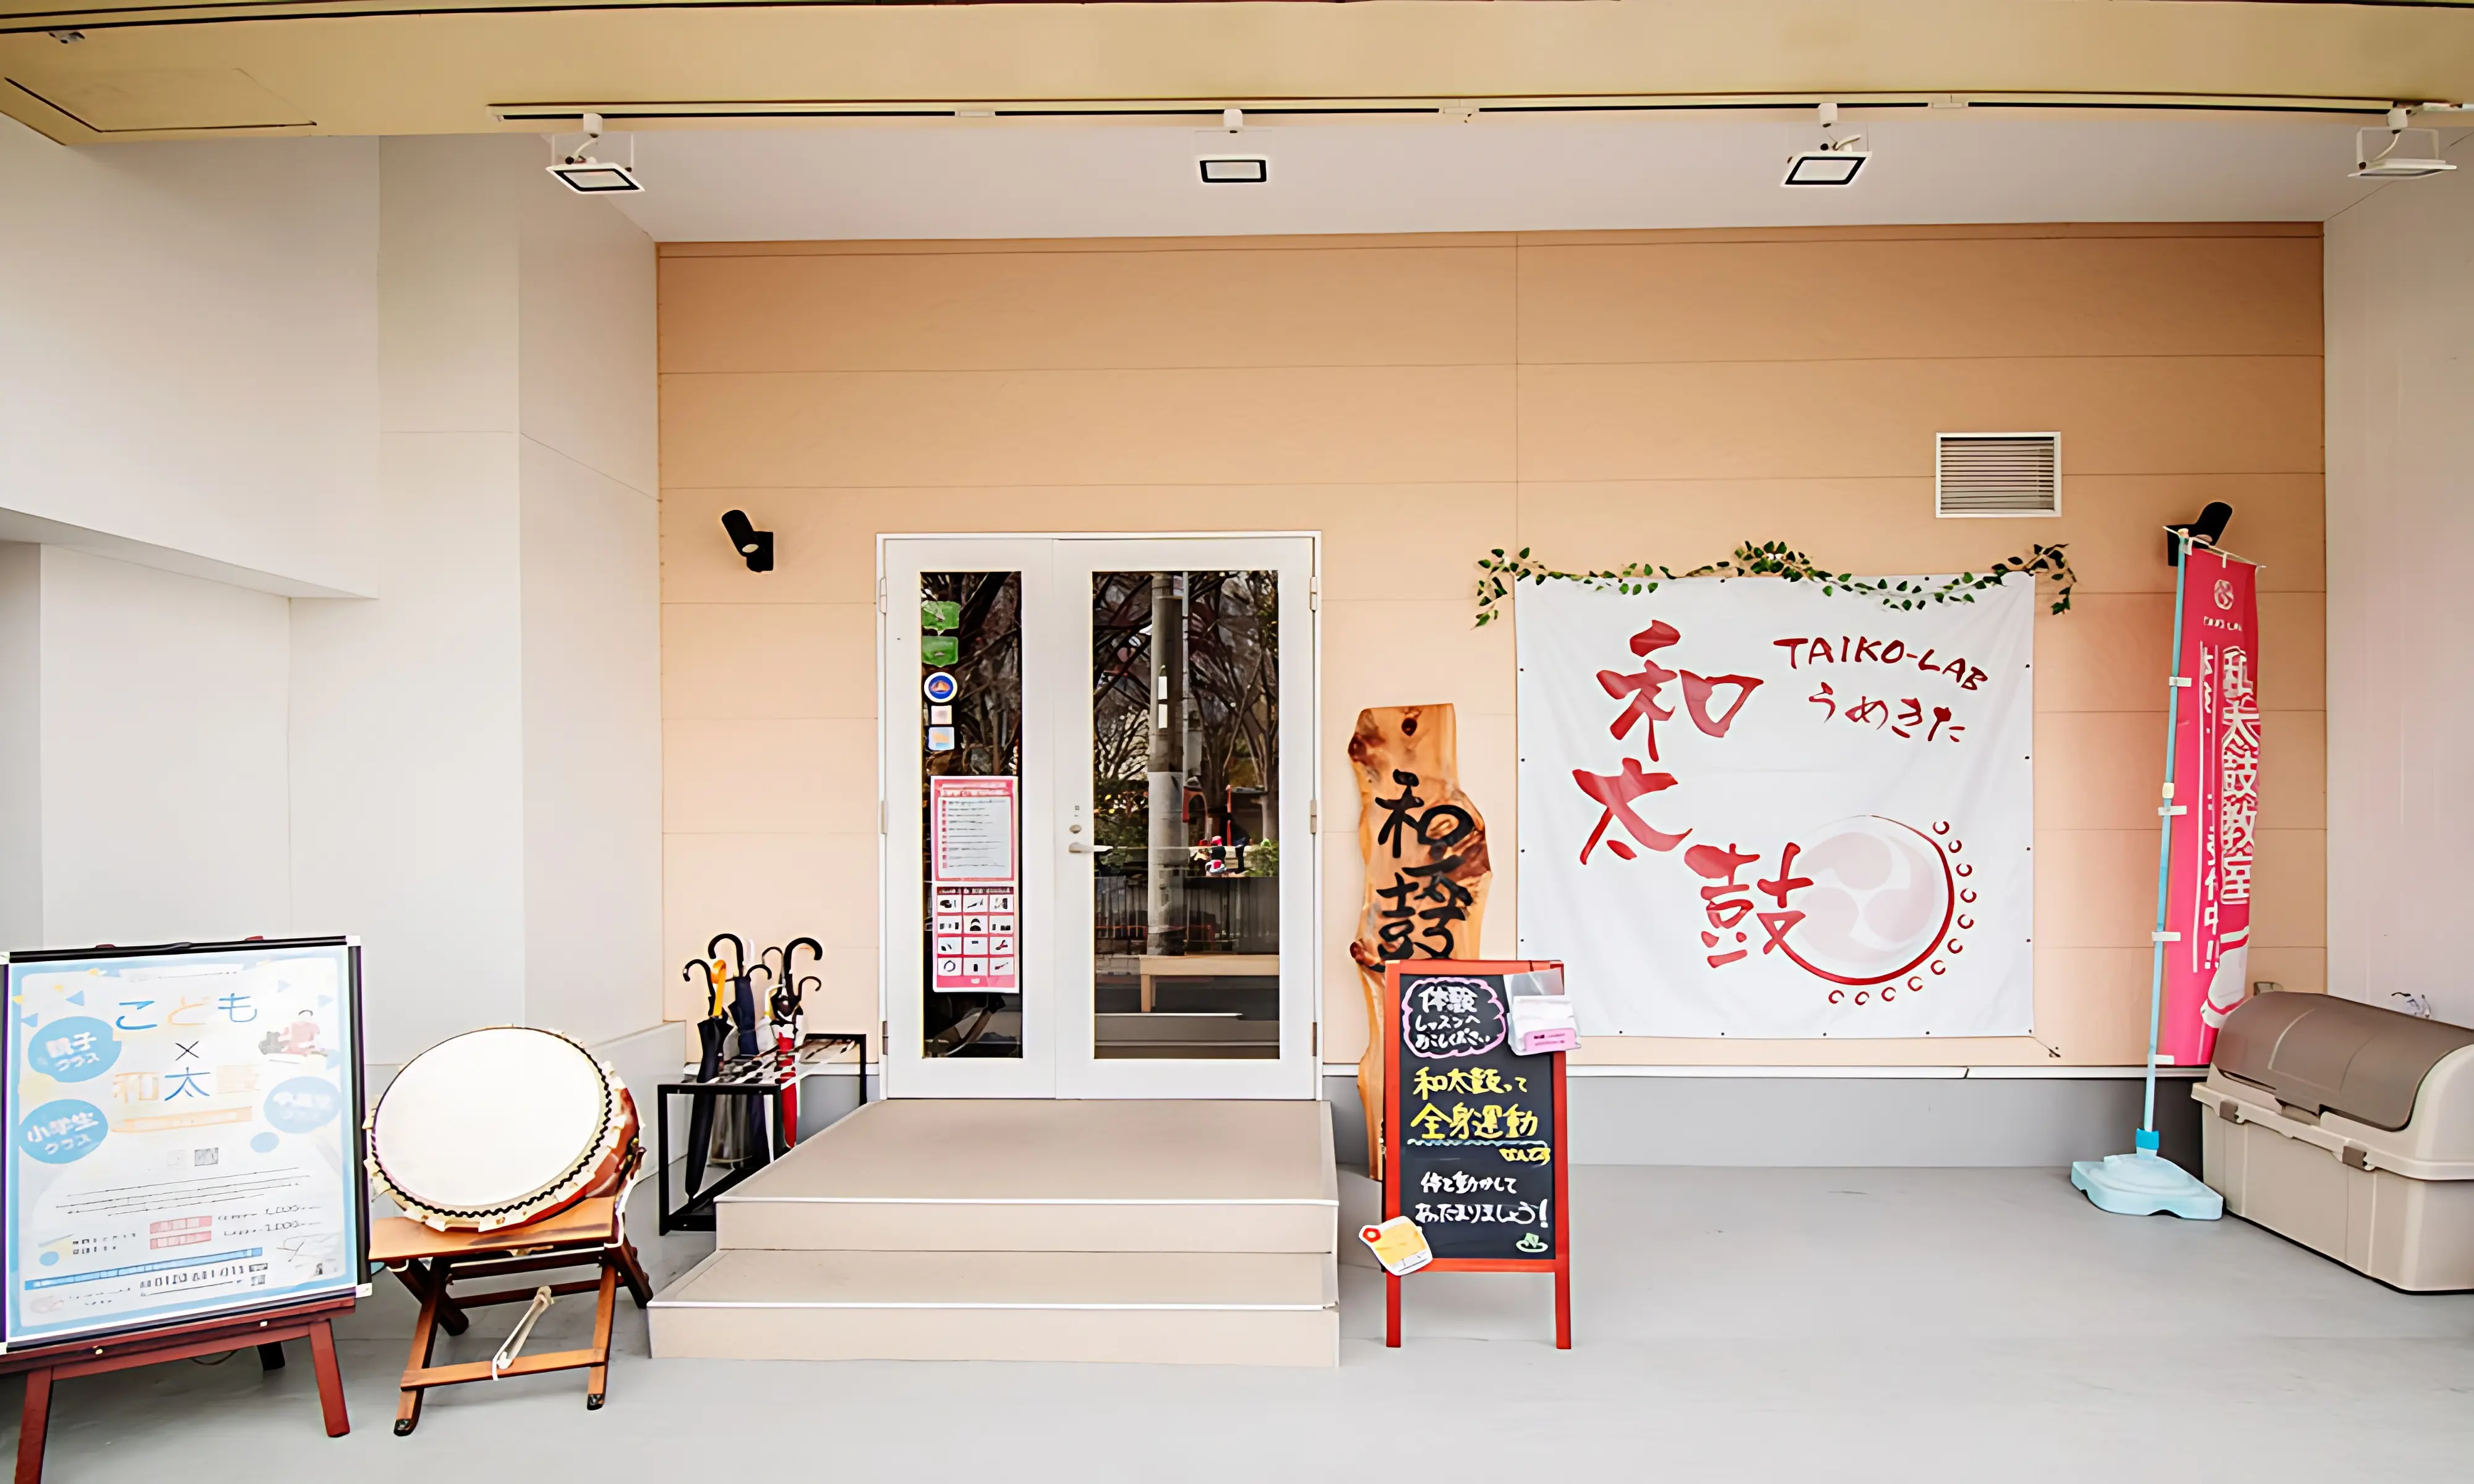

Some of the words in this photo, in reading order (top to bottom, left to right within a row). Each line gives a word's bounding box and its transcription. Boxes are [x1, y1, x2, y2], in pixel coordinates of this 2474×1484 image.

[1773, 635, 1989, 691] TAIKO-LAB
[1808, 681, 1966, 743] うめきた
[1572, 619, 1815, 970] 和太鼓
[115, 992, 257, 1030] こども
[1410, 1101, 1538, 1140] 全身運動
